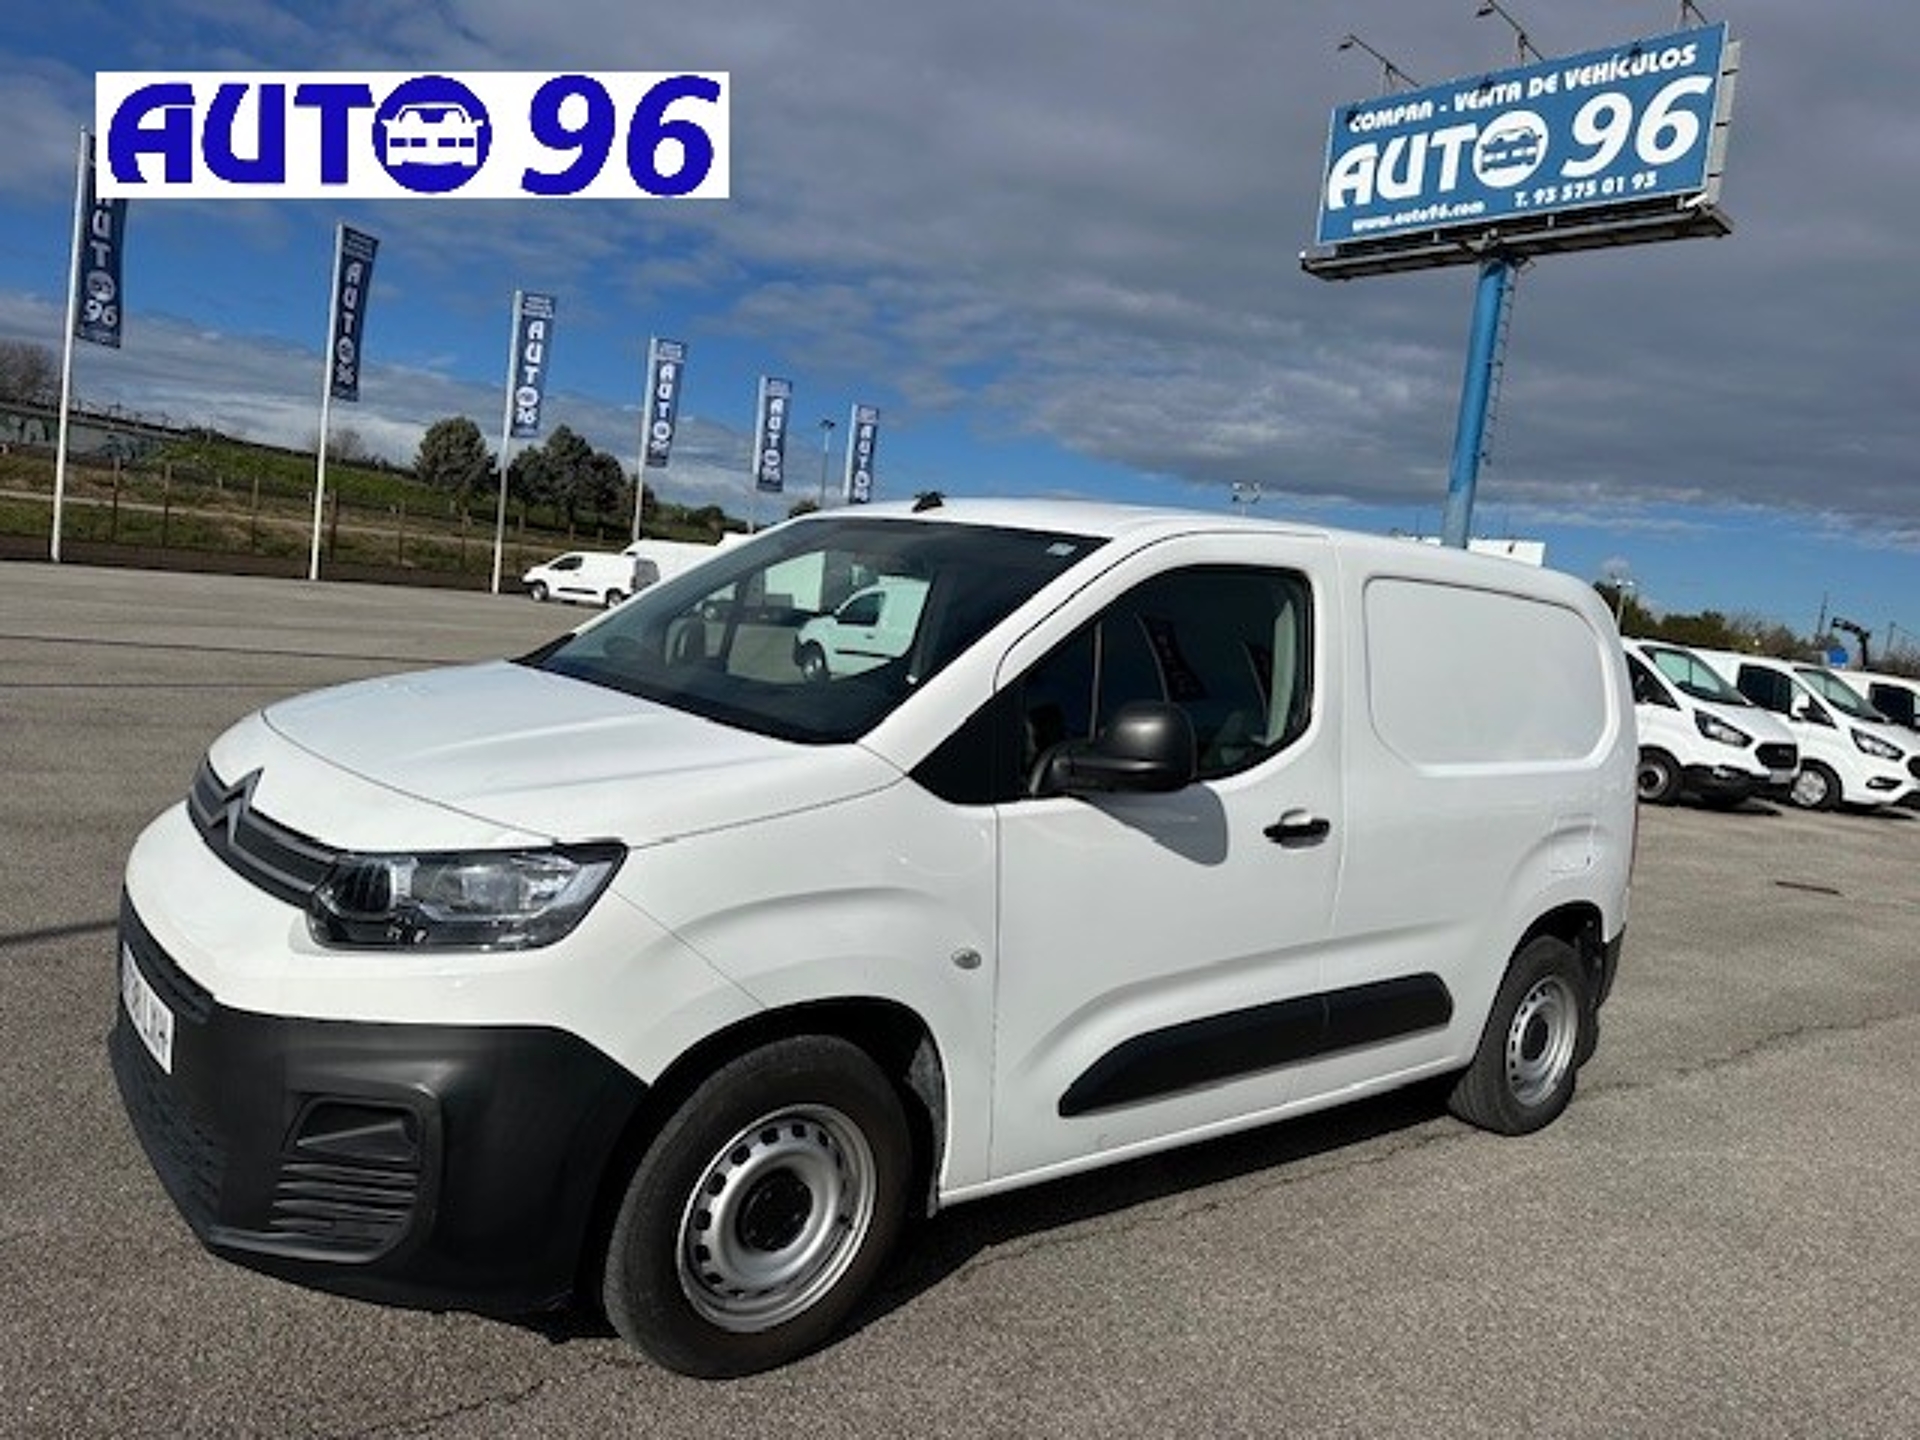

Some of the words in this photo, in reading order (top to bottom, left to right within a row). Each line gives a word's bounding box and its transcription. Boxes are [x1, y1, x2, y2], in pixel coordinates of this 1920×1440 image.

[1349, 100, 1434, 133] COMPRA
[1454, 81, 1522, 112] VENTA
[1527, 71, 1558, 98] DE
[1564, 42, 1698, 91] VEHÍCULOS
[1328, 110, 1549, 211] AUTO
[1560, 76, 1714, 178] 96
[1562, 179, 1597, 201] 575
[1601, 176, 1625, 195] 01
[84, 299, 118, 328] 96
[337, 261, 364, 365] AUTO
[516, 320, 545, 407] AUTO
